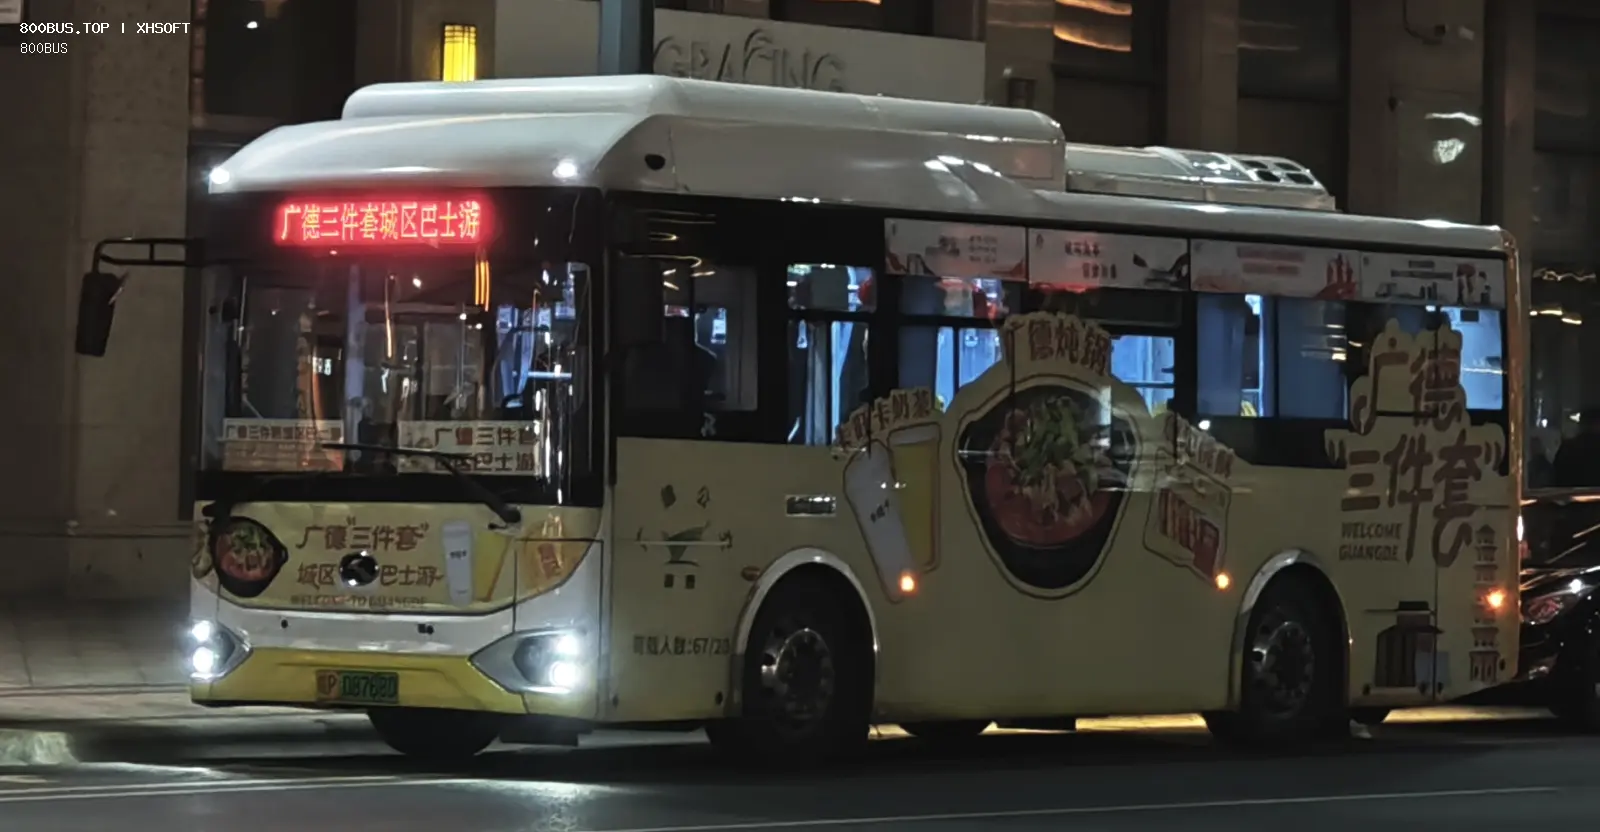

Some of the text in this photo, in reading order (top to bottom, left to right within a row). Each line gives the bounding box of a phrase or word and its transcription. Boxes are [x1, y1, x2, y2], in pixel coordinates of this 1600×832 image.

[281, 203, 481, 240] 广德三件套城区巴士游
[1351, 337, 1462, 434] 广德
[1341, 521, 1404, 540] WELCOME
[296, 561, 337, 590] 城区
